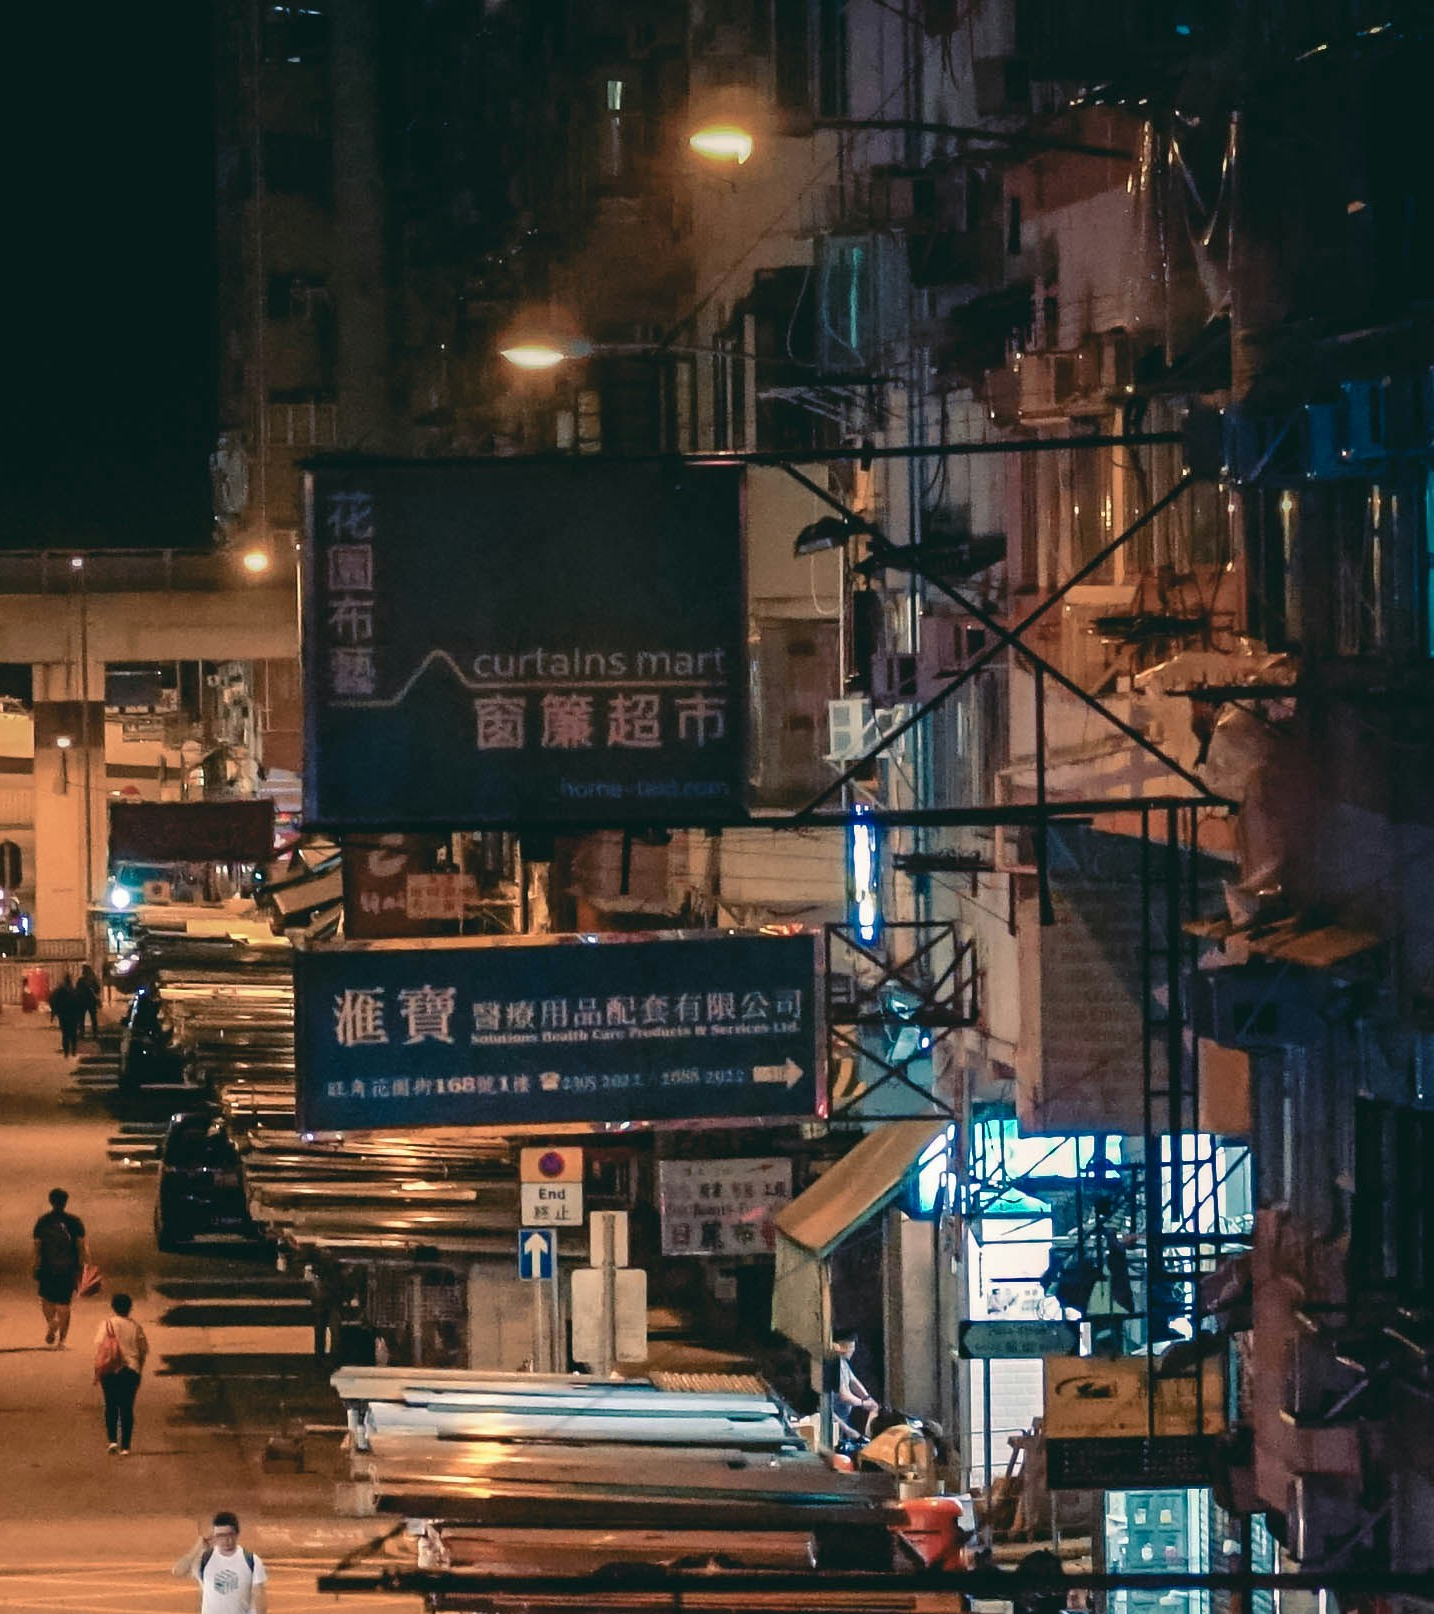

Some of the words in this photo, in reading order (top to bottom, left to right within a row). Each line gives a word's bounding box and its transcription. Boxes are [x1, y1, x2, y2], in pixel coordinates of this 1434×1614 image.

[473, 649, 622, 680] curtains
[636, 651, 726, 679] mart
[476, 694, 728, 751] 窗簾超市
[538, 1187, 566, 1201] End
